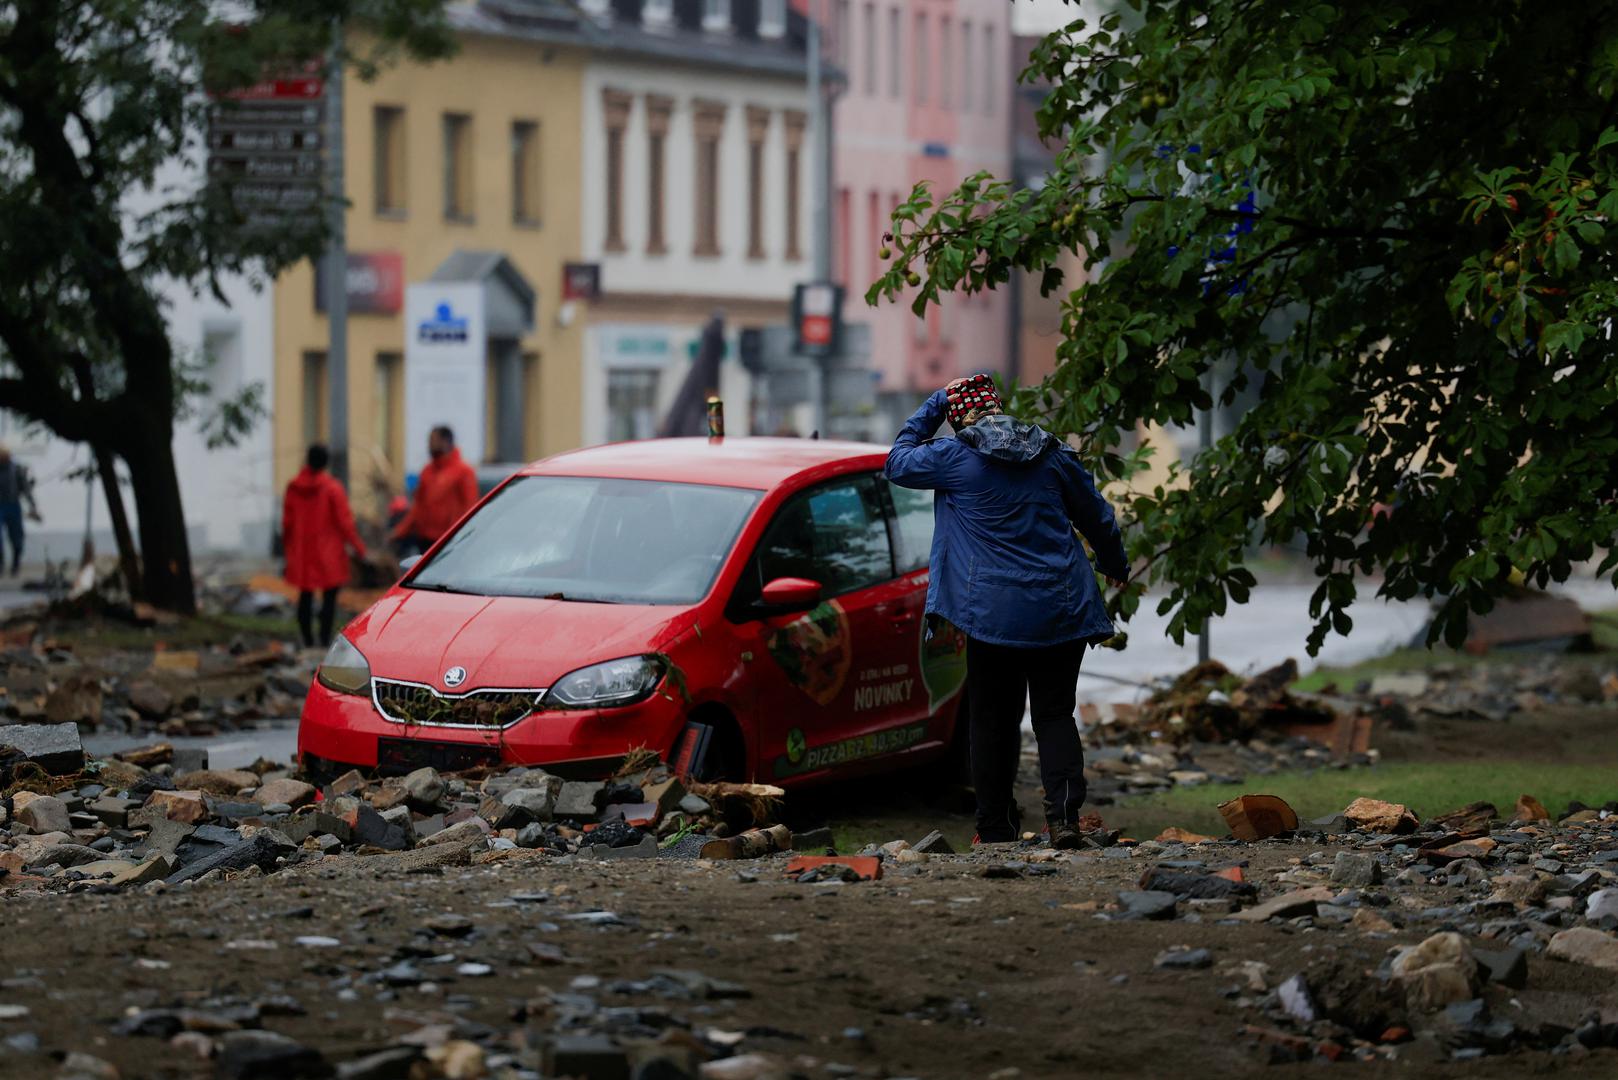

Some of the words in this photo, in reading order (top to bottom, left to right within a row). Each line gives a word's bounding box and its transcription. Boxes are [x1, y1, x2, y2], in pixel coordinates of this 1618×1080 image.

[854, 678, 914, 712] NOVINKY
[807, 743, 846, 769] PIZZA
[908, 727, 924, 743] cm
